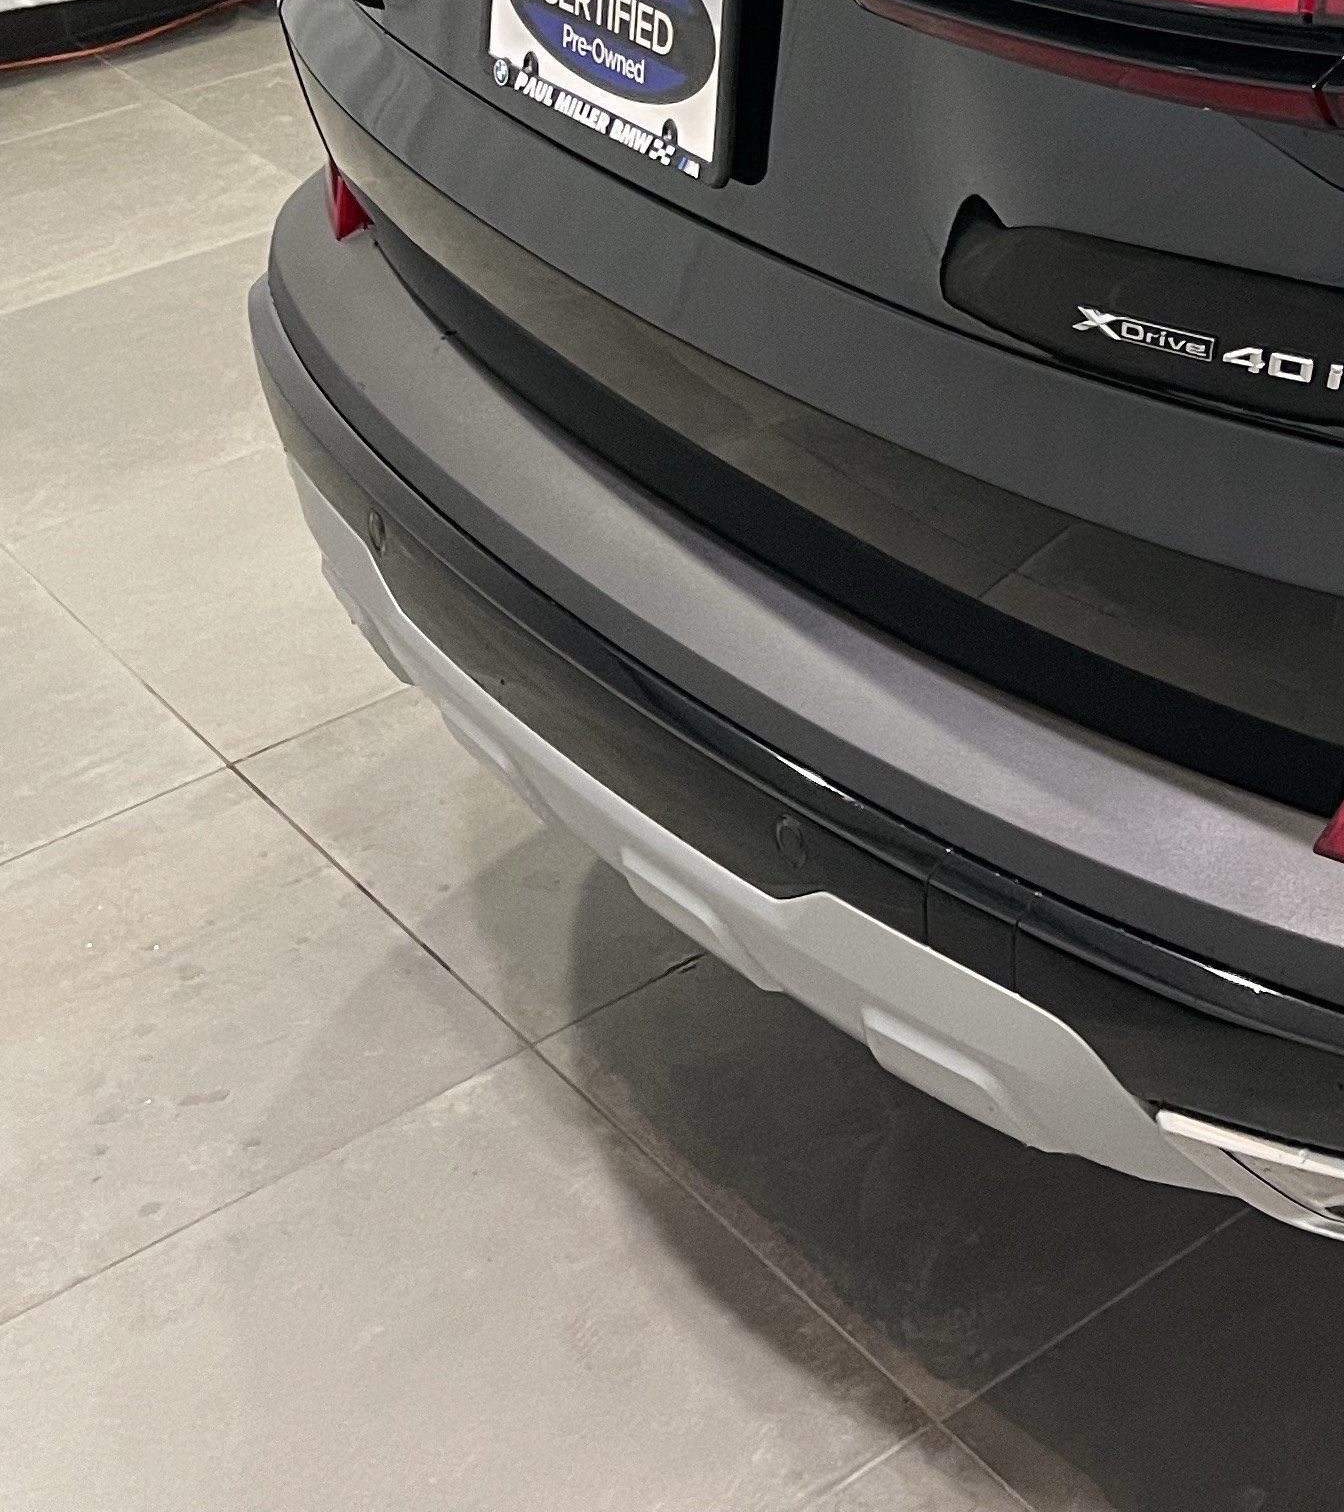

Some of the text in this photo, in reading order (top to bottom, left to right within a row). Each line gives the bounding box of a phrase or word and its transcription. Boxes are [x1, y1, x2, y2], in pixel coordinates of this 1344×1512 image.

[562, 23, 645, 84] Pre-Owned
[514, 71, 654, 154] PAUL MILLER BMW
